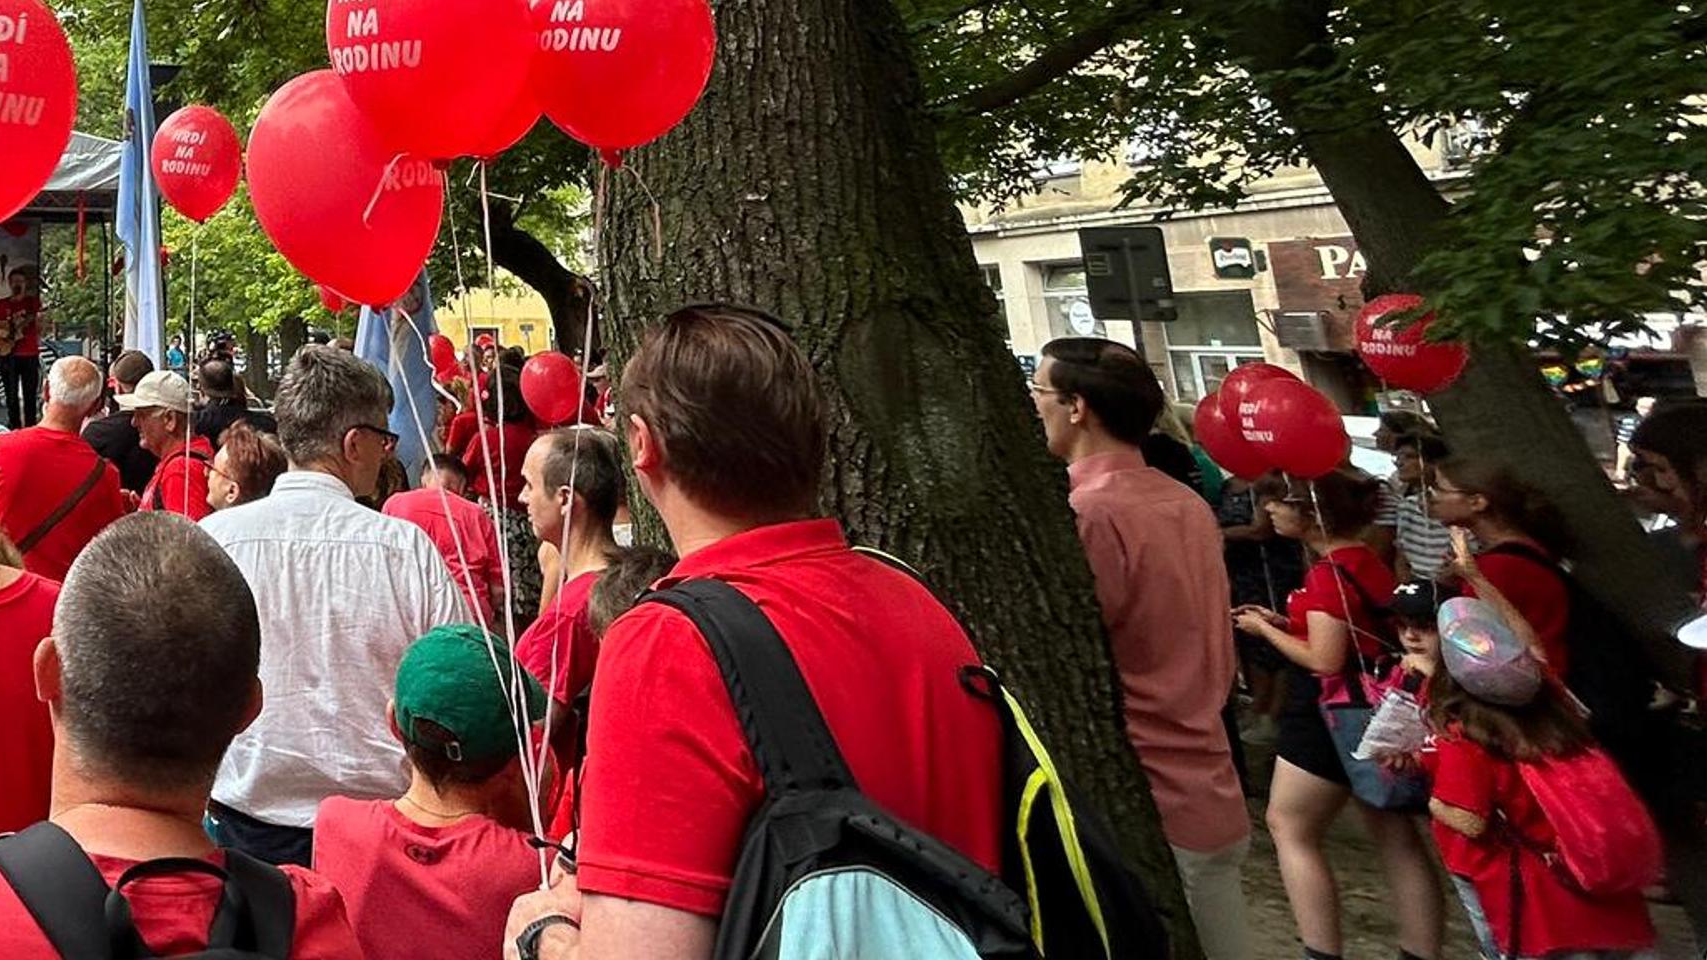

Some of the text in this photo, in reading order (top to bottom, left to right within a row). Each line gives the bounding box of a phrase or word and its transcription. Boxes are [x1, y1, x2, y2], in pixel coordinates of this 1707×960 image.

[347, 7, 378, 38] NA
[550, 0, 584, 22] NA
[535, 27, 621, 51] ODINU
[333, 40, 422, 75] RODINU
[175, 145, 194, 159] NA
[161, 159, 211, 176] RODINU
